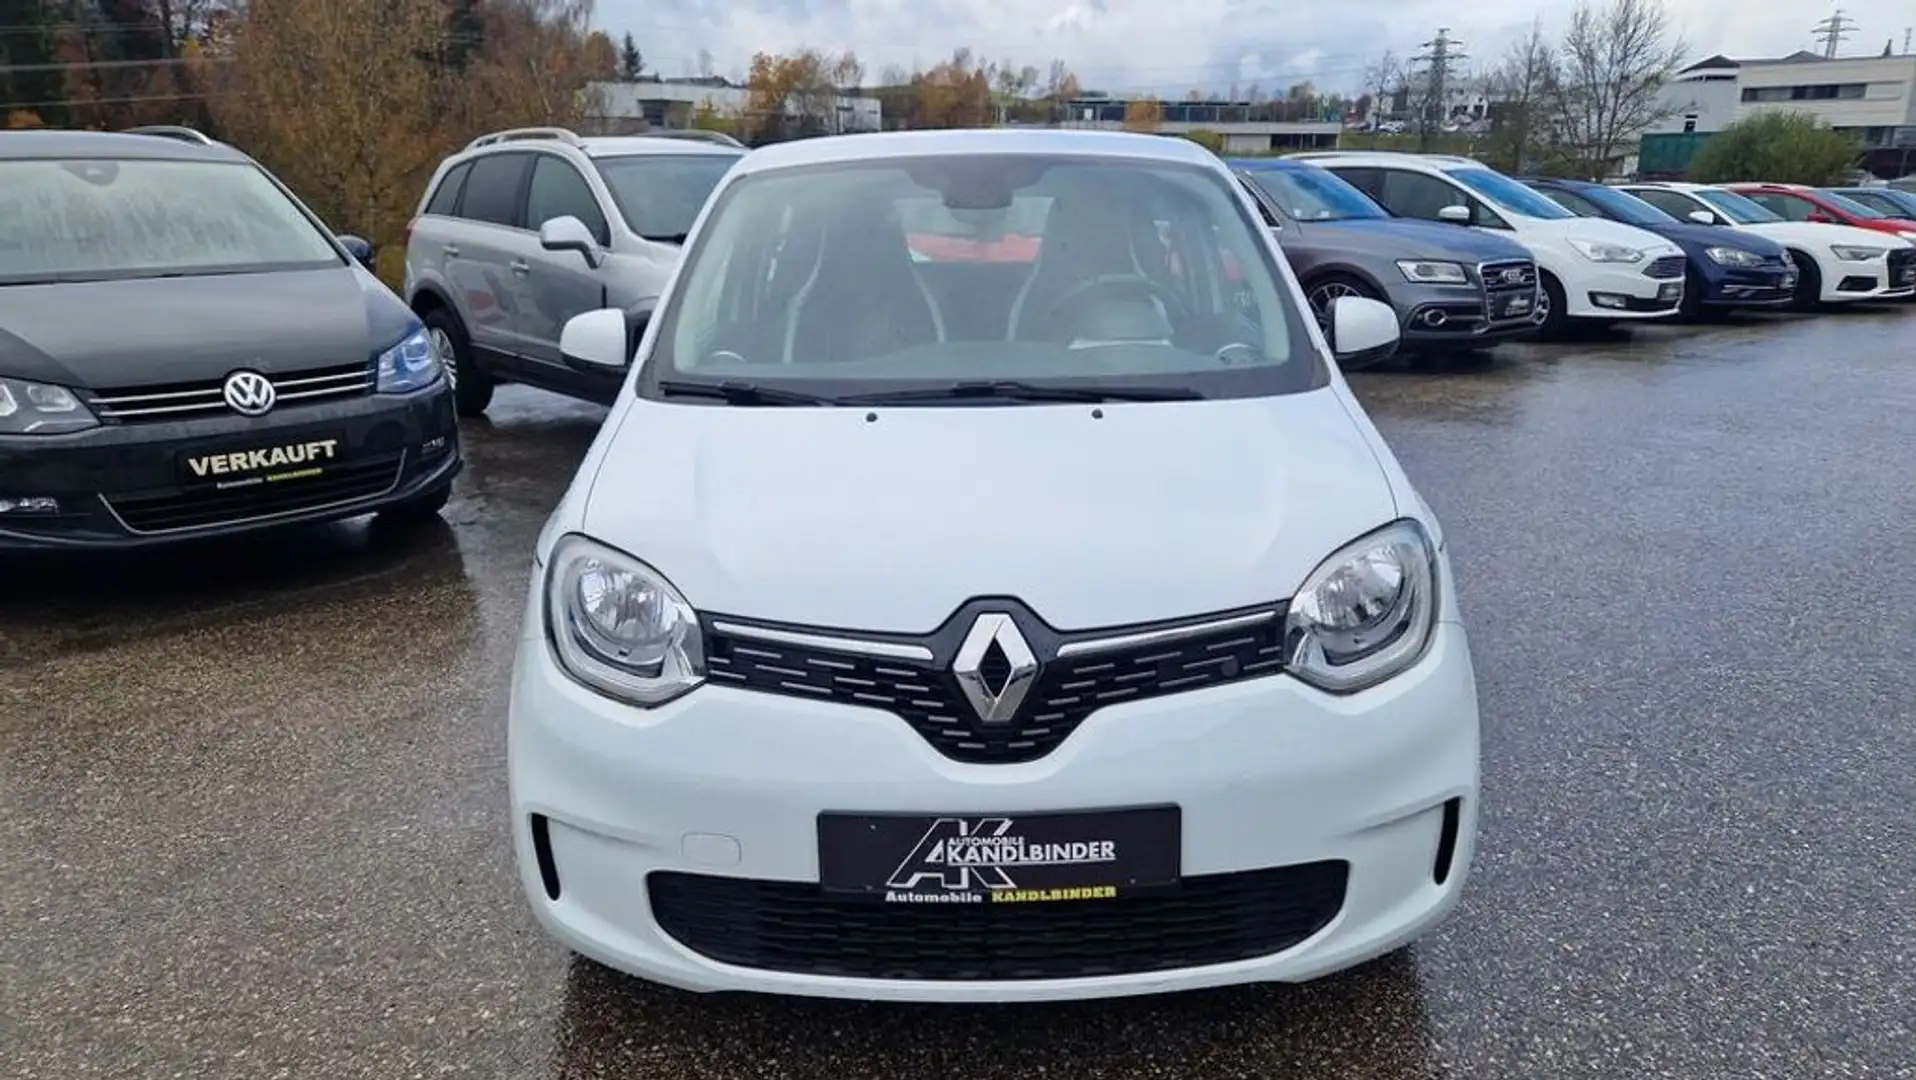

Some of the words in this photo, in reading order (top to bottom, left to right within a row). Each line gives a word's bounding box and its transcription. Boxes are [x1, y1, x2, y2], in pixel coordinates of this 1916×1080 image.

[188, 439, 338, 477] VERKAUFT
[947, 835, 1025, 847] AUTOMOBILE
[947, 840, 1117, 864] KANDLBINDER
[885, 890, 983, 903] Automobile
[990, 886, 1117, 903] KANDLBINDER
